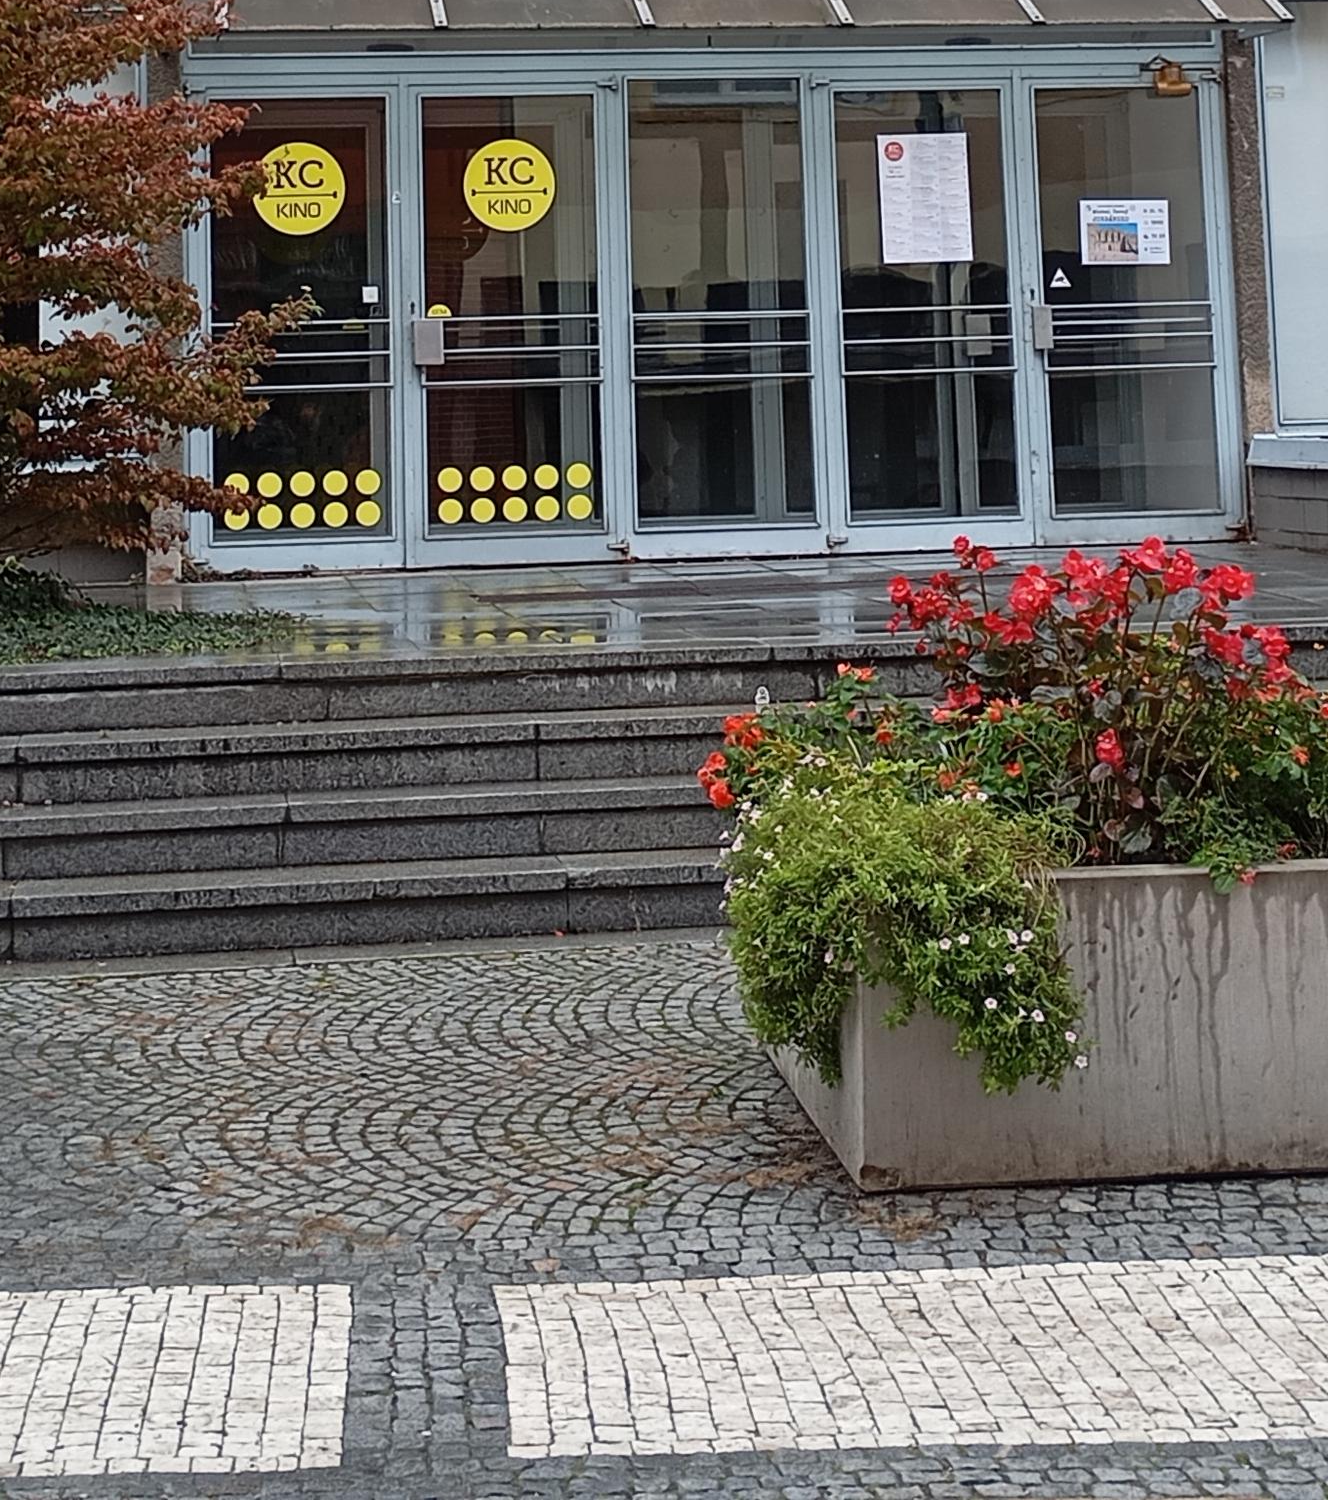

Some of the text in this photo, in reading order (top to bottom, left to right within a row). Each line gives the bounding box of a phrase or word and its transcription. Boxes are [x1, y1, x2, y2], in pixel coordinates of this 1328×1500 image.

[273, 160, 324, 188] KC
[484, 157, 534, 185] KC
[276, 202, 321, 218] KINO
[488, 199, 532, 215] KINO
